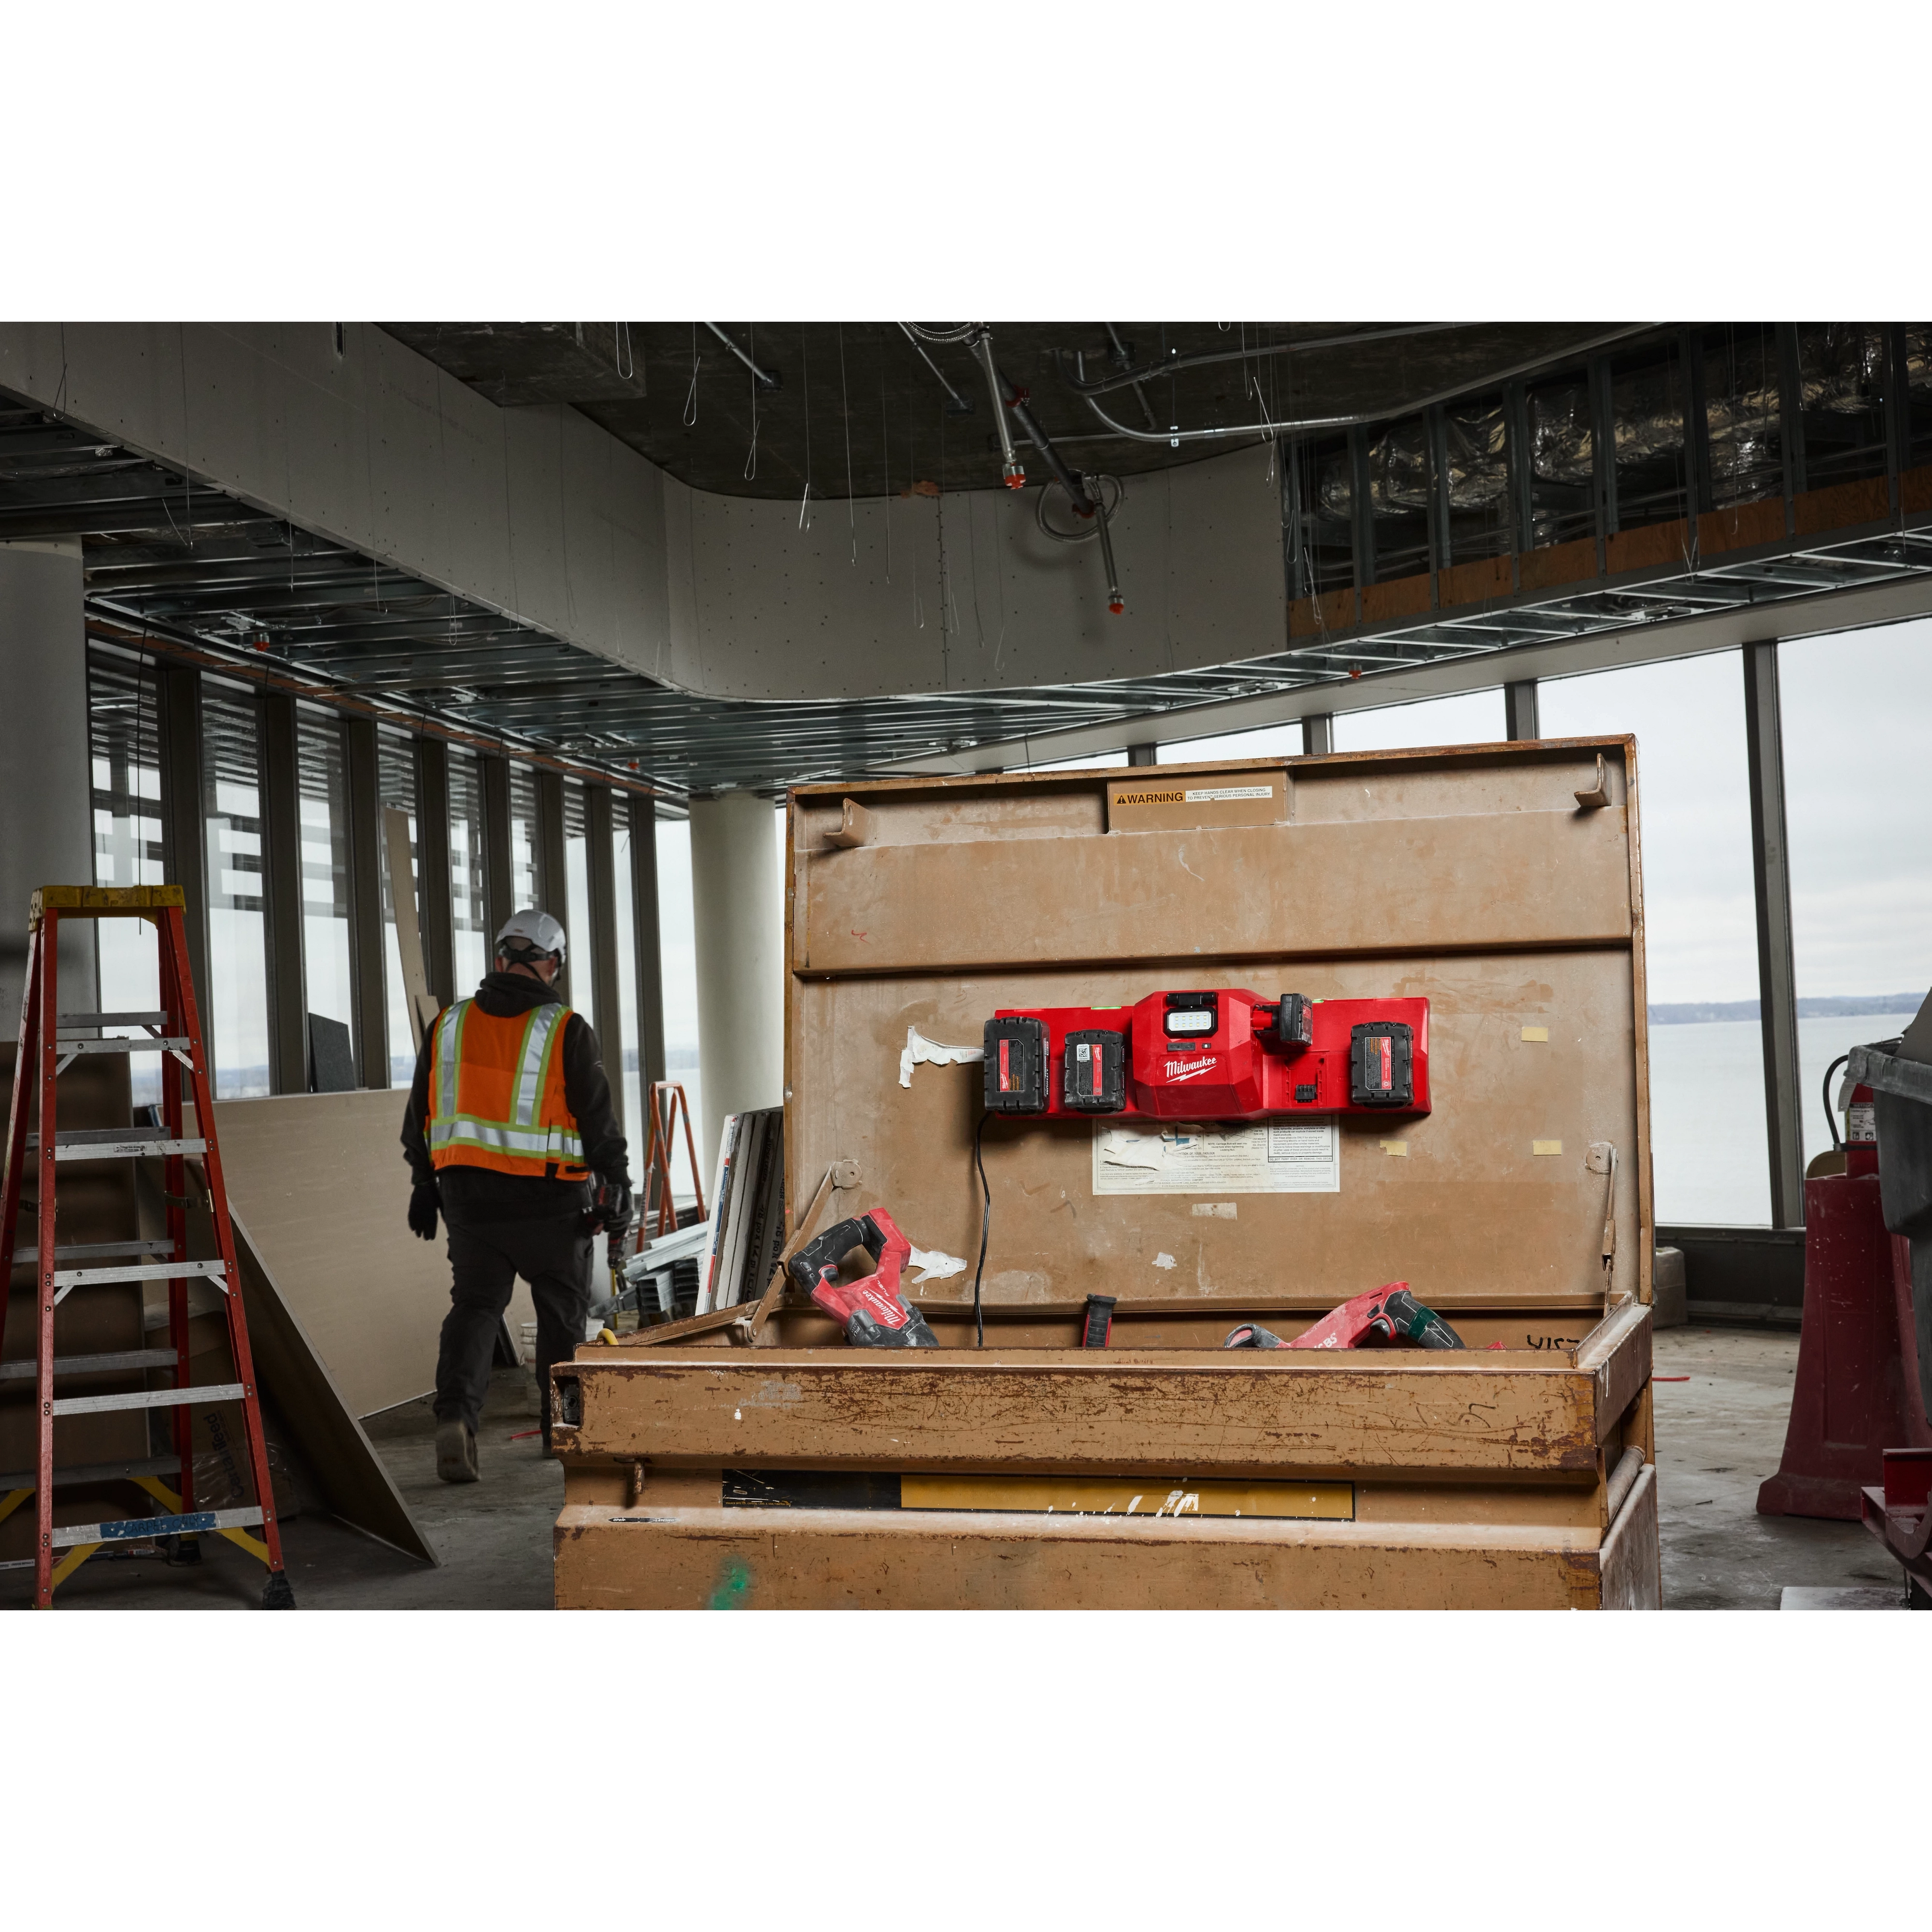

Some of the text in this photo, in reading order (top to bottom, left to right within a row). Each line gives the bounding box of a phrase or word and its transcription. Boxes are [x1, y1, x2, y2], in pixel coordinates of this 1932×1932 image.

[1127, 792, 1183, 804] WARNING
[1164, 1056, 1217, 1078] Milwaukee
[878, 1279, 890, 1296] FUEL
[863, 1289, 901, 1325] Milwaukee
[124, 1513, 199, 1534] CARPET ONLY
